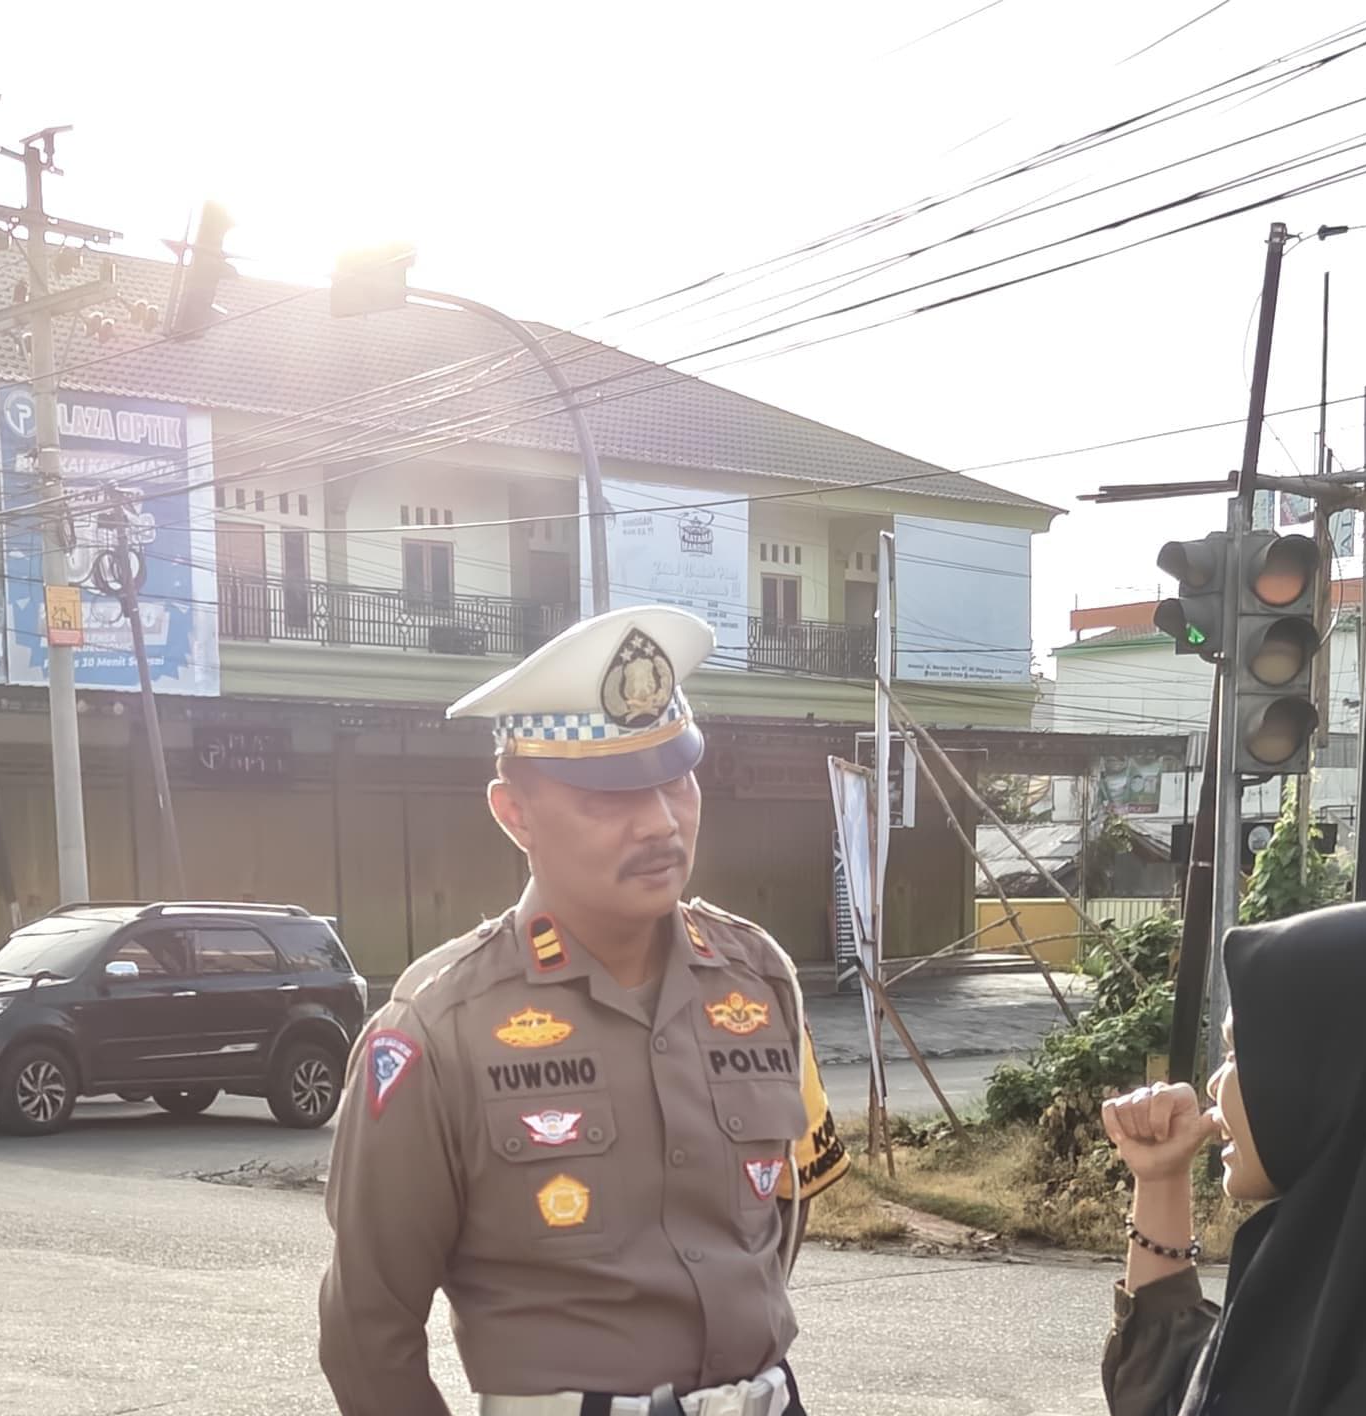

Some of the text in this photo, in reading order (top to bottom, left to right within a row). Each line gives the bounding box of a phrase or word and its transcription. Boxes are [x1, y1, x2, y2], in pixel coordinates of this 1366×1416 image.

[58, 403, 182, 449] LAZA OPTIK
[487, 1056, 596, 1092] YUWONO
[709, 1048, 792, 1075] POLRI
